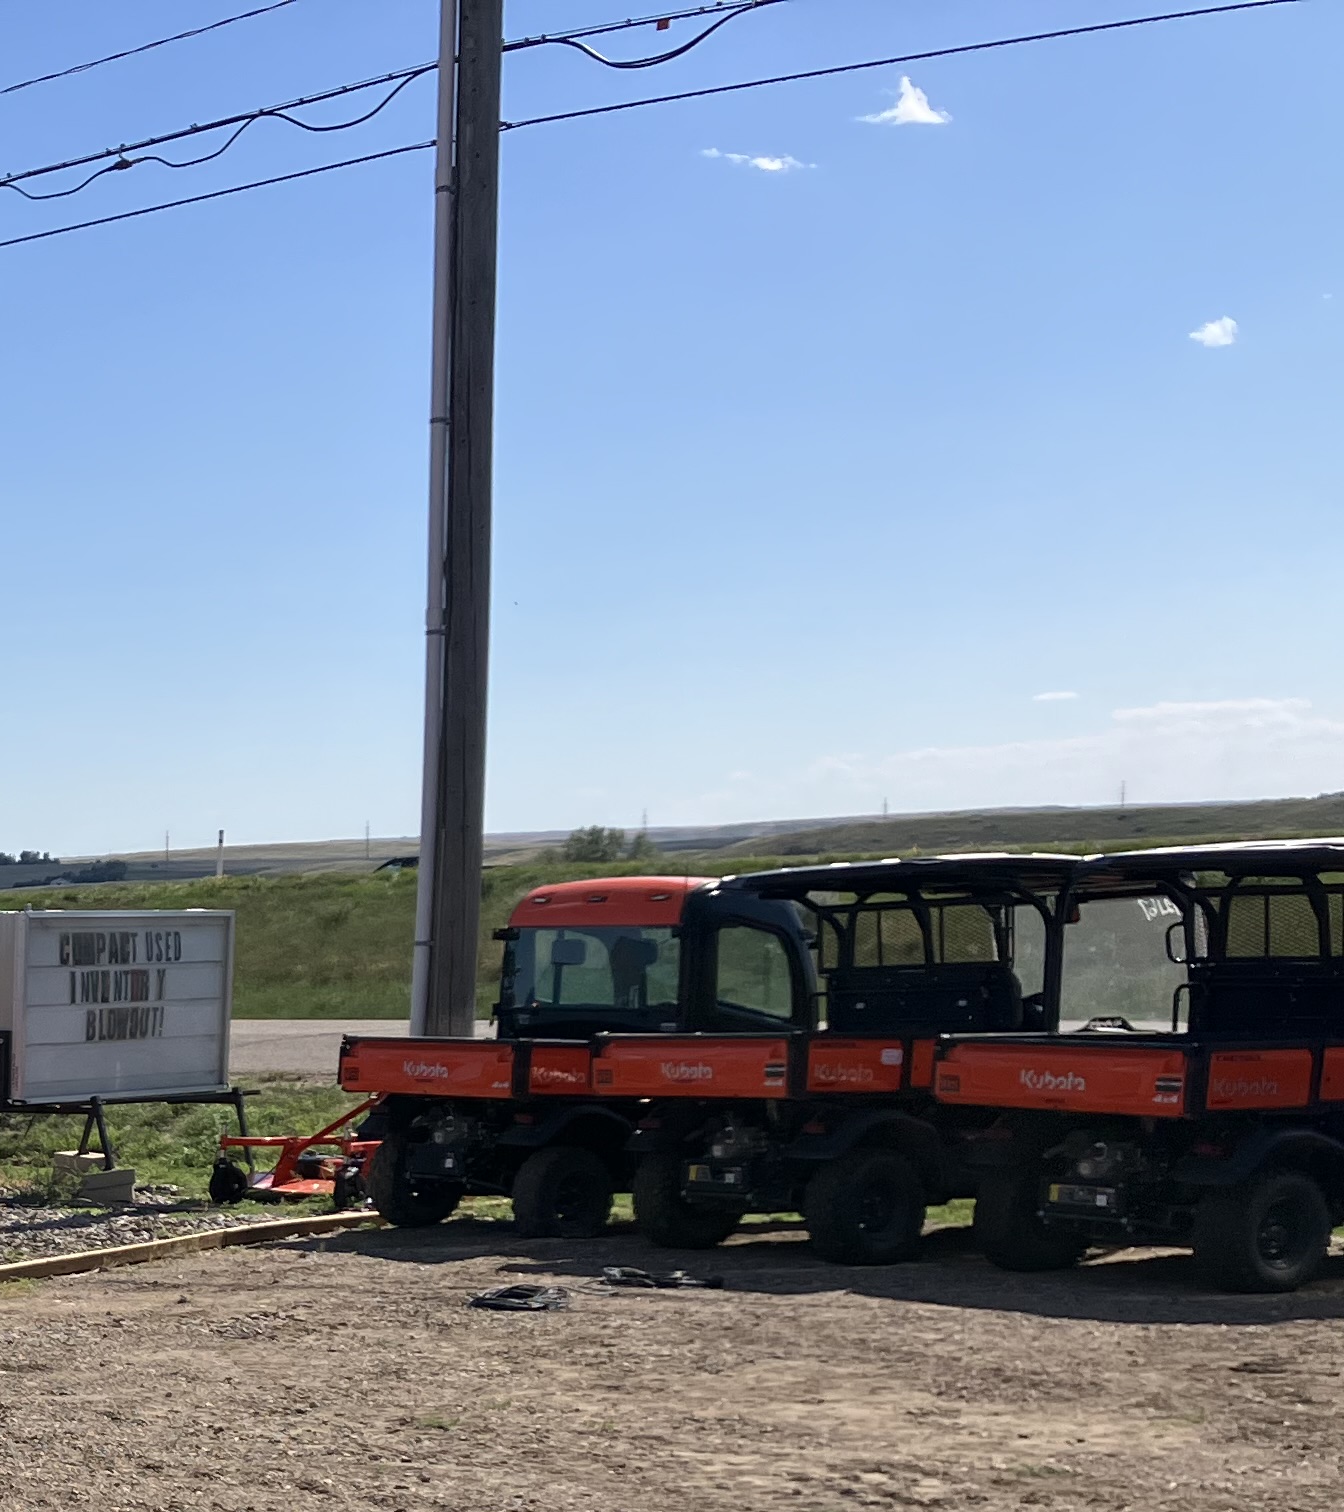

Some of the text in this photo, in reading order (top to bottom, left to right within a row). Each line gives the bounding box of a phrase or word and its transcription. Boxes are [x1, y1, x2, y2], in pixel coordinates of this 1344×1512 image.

[59, 930, 182, 966] CPACT USED
[403, 1060, 449, 1079] Kubota
[661, 1062, 713, 1081] Kubota
[1020, 1069, 1086, 1091] Kubota
